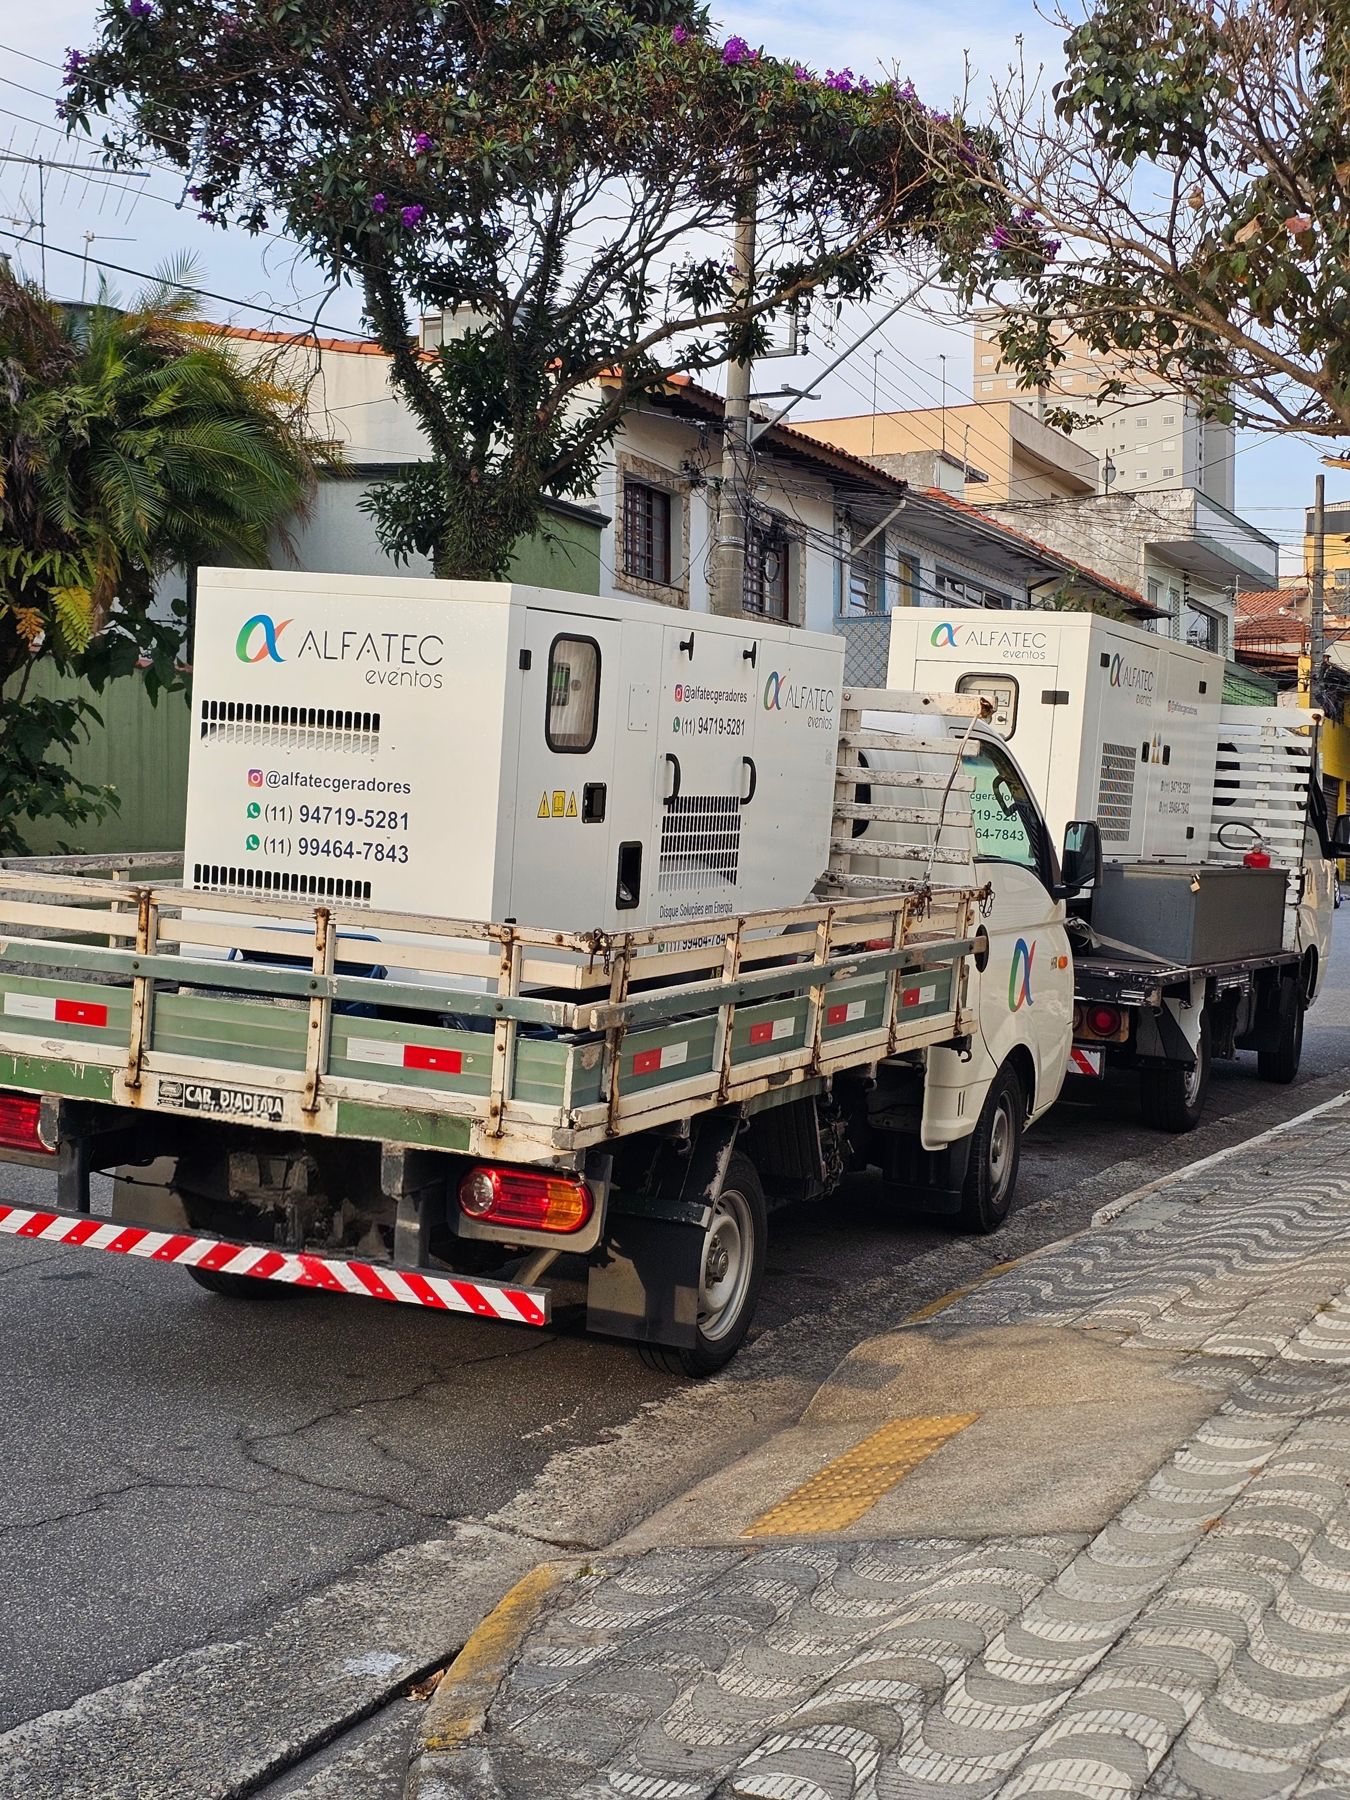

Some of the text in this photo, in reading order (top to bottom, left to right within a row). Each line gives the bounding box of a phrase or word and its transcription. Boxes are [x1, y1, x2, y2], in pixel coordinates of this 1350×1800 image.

[298, 629, 444, 666] ALFATEC
[965, 630, 1047, 649] ALFATEC
[1002, 649, 1046, 660] eventos
[365, 669, 444, 689] eventos
[1122, 665, 1154, 692] ALFATEC
[683, 684, 748, 704] @alfatecgeradores
[785, 684, 835, 713] ALFATEC
[681, 716, 746, 737] (11) 94719-5281
[807, 716, 833, 731] eventos
[265, 770, 412, 794] @alfatecgeradores
[264, 803, 410, 831] (11) 94719-5281
[263, 835, 409, 864] (11) 99464-7843
[659, 900, 733, 920] Disque Soluções em Energia
